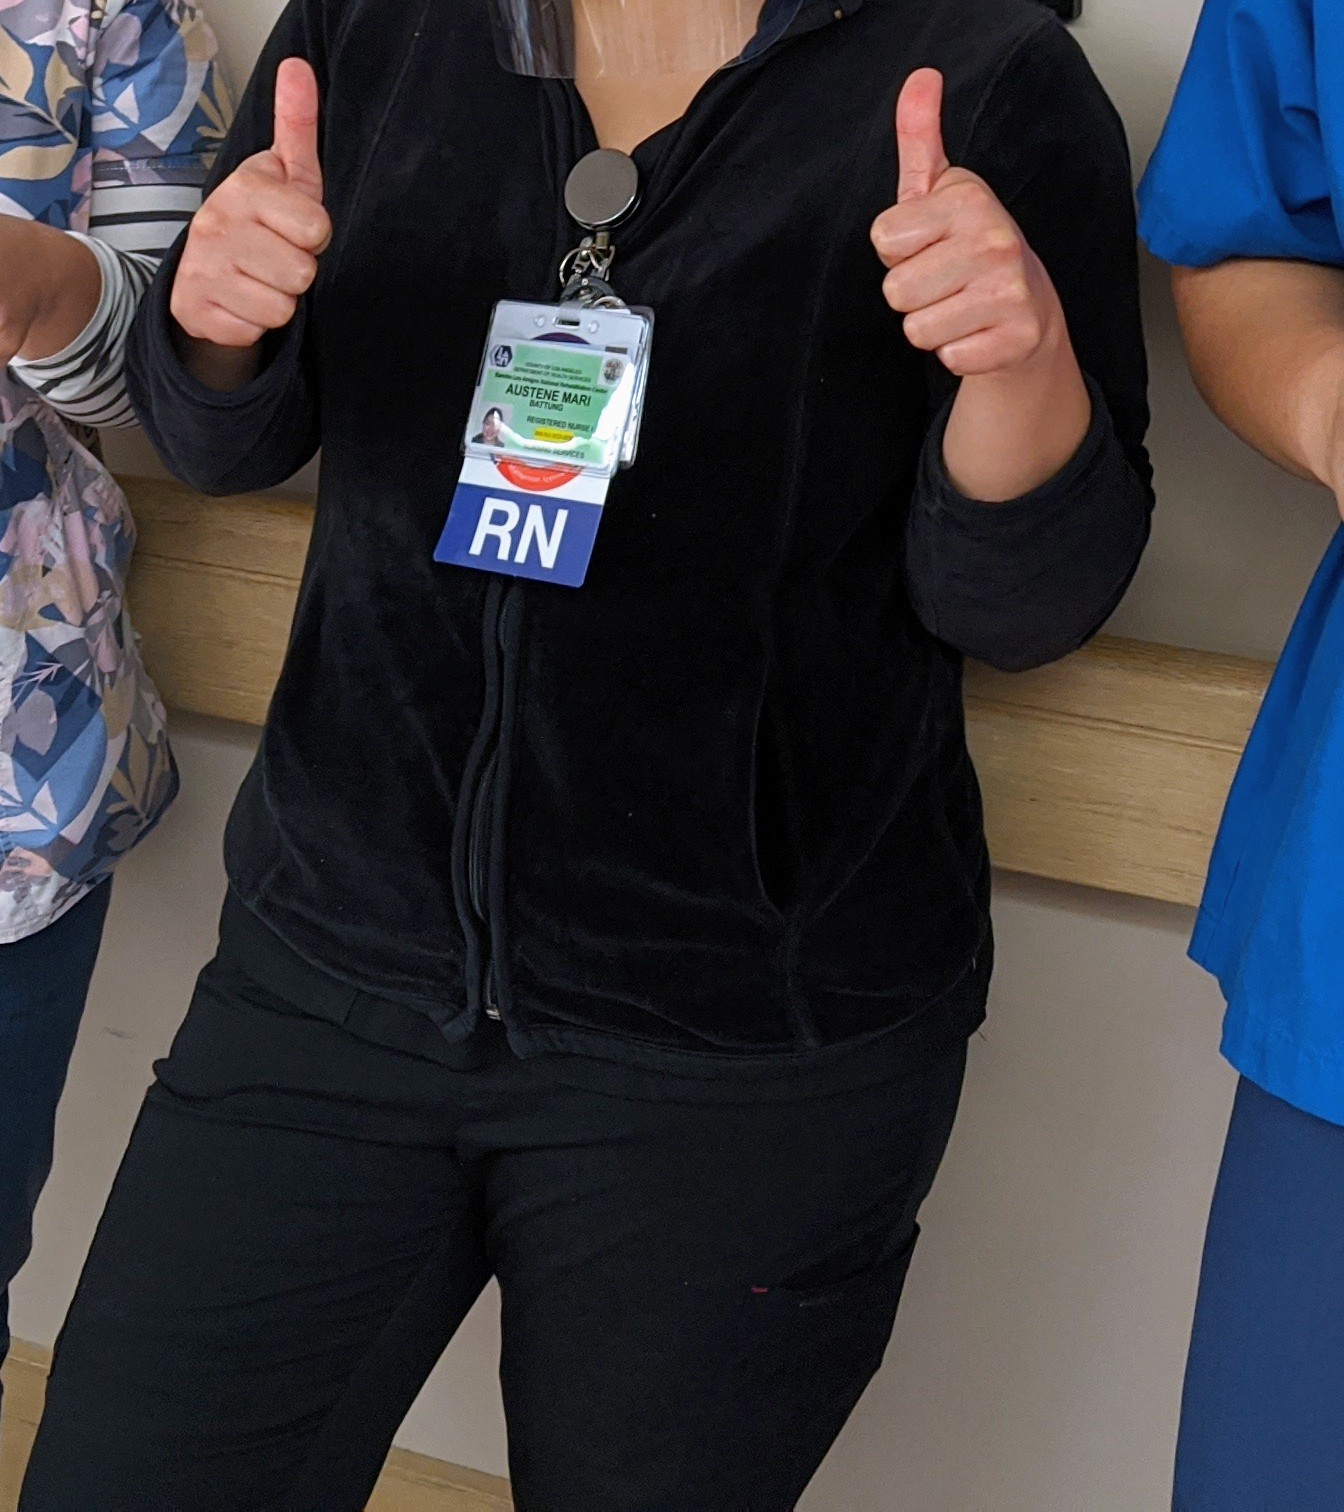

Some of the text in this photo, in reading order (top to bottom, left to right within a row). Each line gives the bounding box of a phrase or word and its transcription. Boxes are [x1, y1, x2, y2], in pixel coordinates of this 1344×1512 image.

[505, 383, 591, 407] AUSTENE MARI
[530, 399, 564, 411] BATTUNG
[527, 415, 567, 428] REGISTERED
[568, 422, 590, 432] NURSE
[468, 497, 568, 569] RN
